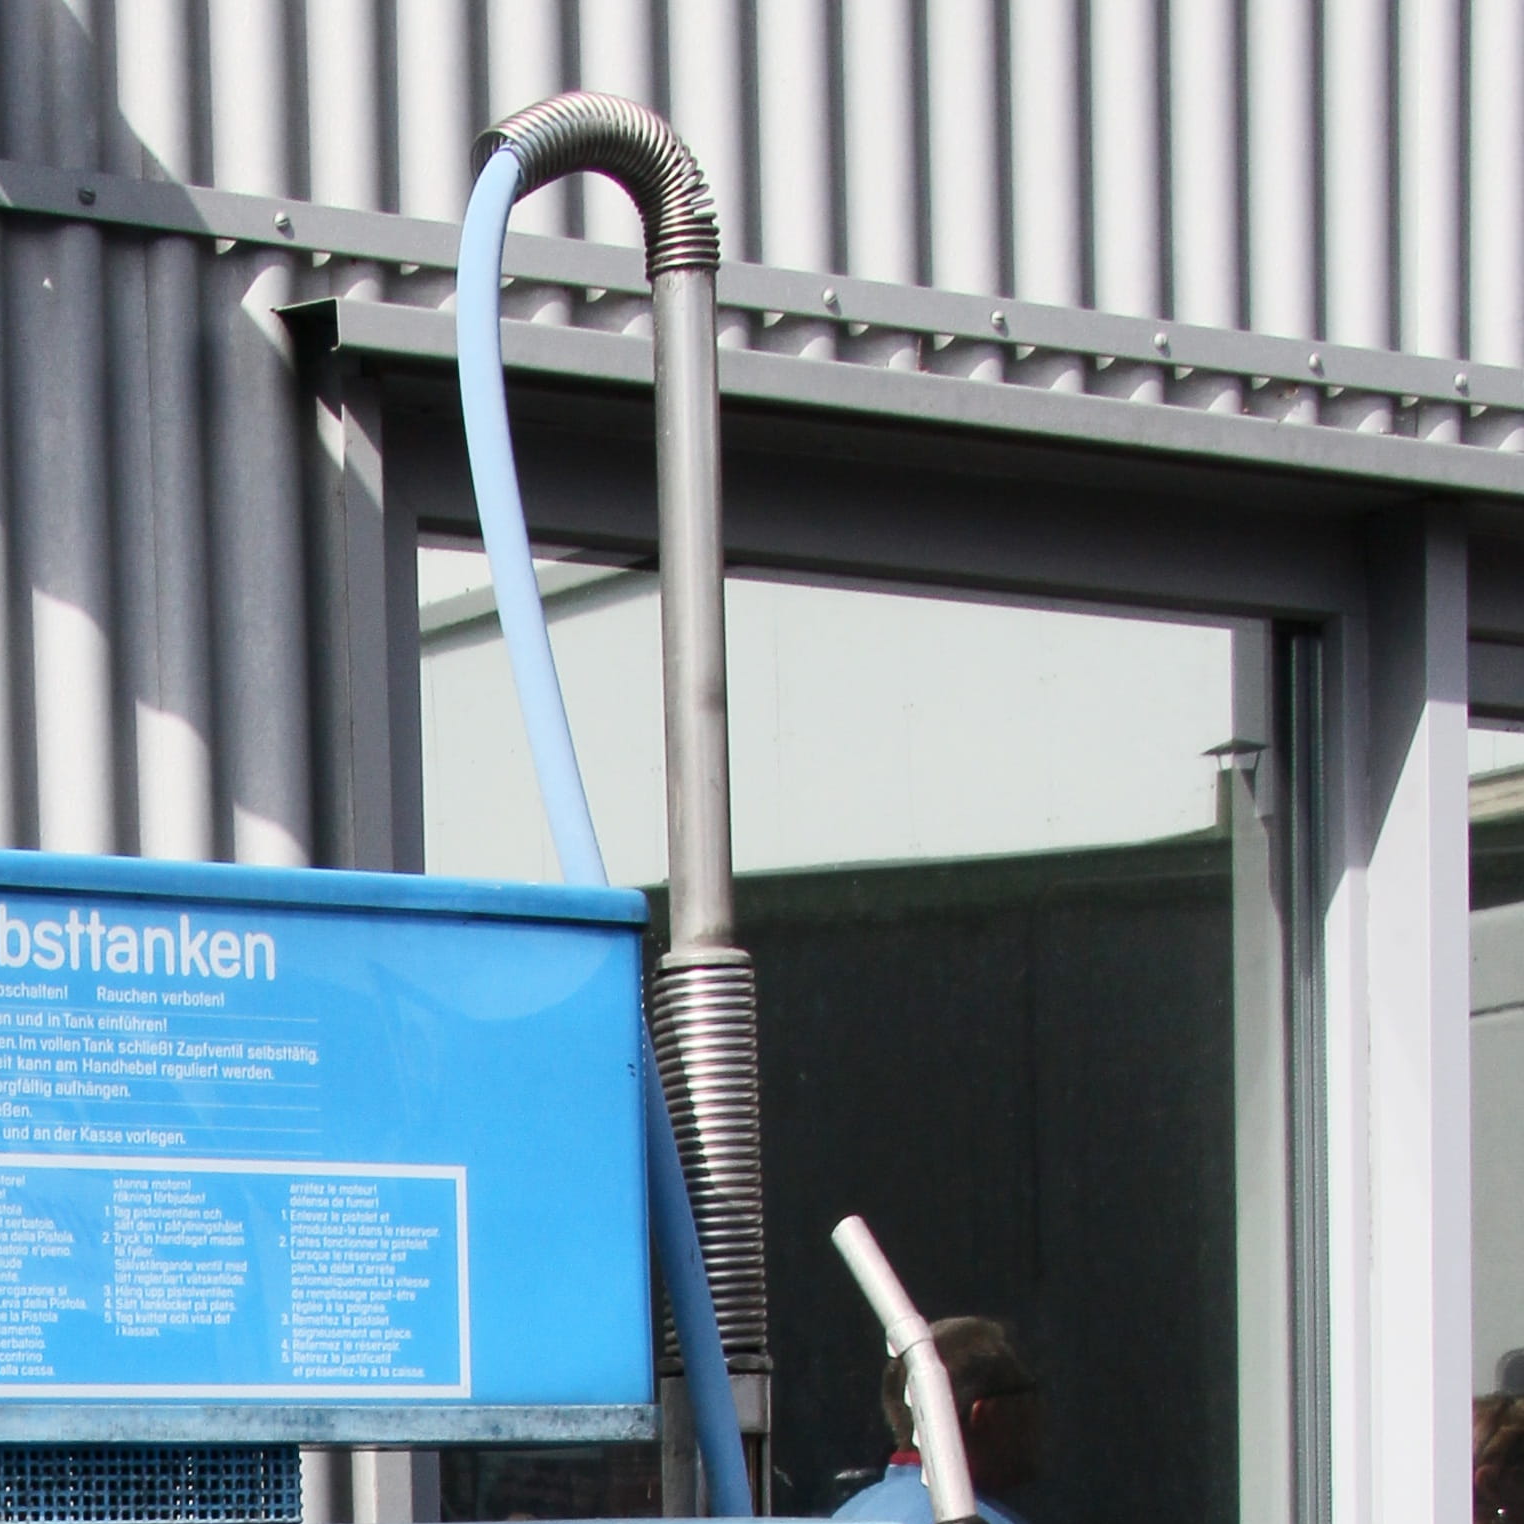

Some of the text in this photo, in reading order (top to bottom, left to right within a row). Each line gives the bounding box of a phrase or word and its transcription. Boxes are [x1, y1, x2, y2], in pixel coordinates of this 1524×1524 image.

[97, 986, 157, 1004] Rauchen
[162, 991, 225, 1007] verboten!
[16, 1011, 42, 1027] und
[48, 1011, 60, 1027] in
[64, 1013, 94, 1028] Tank
[98, 1015, 167, 1032] einführen!
[40, 1036, 80, 1052] vollen
[84, 1038, 114, 1053] Tank
[118, 1040, 172, 1057] schließt
[177, 1041, 243, 1060] Zapfventil
[18, 1056, 51, 1072] kann
[56, 1058, 77, 1073] am
[83, 1058, 156, 1075] Handhebel
[161, 1062, 218, 1078] reguliert
[222, 1064, 275, 1080] werden.
[55, 1079, 130, 1100] aufhängen.
[3, 1125, 27, 1140] und
[34, 1127, 49, 1141] an
[54, 1125, 76, 1141] der
[80, 1127, 122, 1143] Kasse
[126, 1128, 185, 1147] vorlegen.
